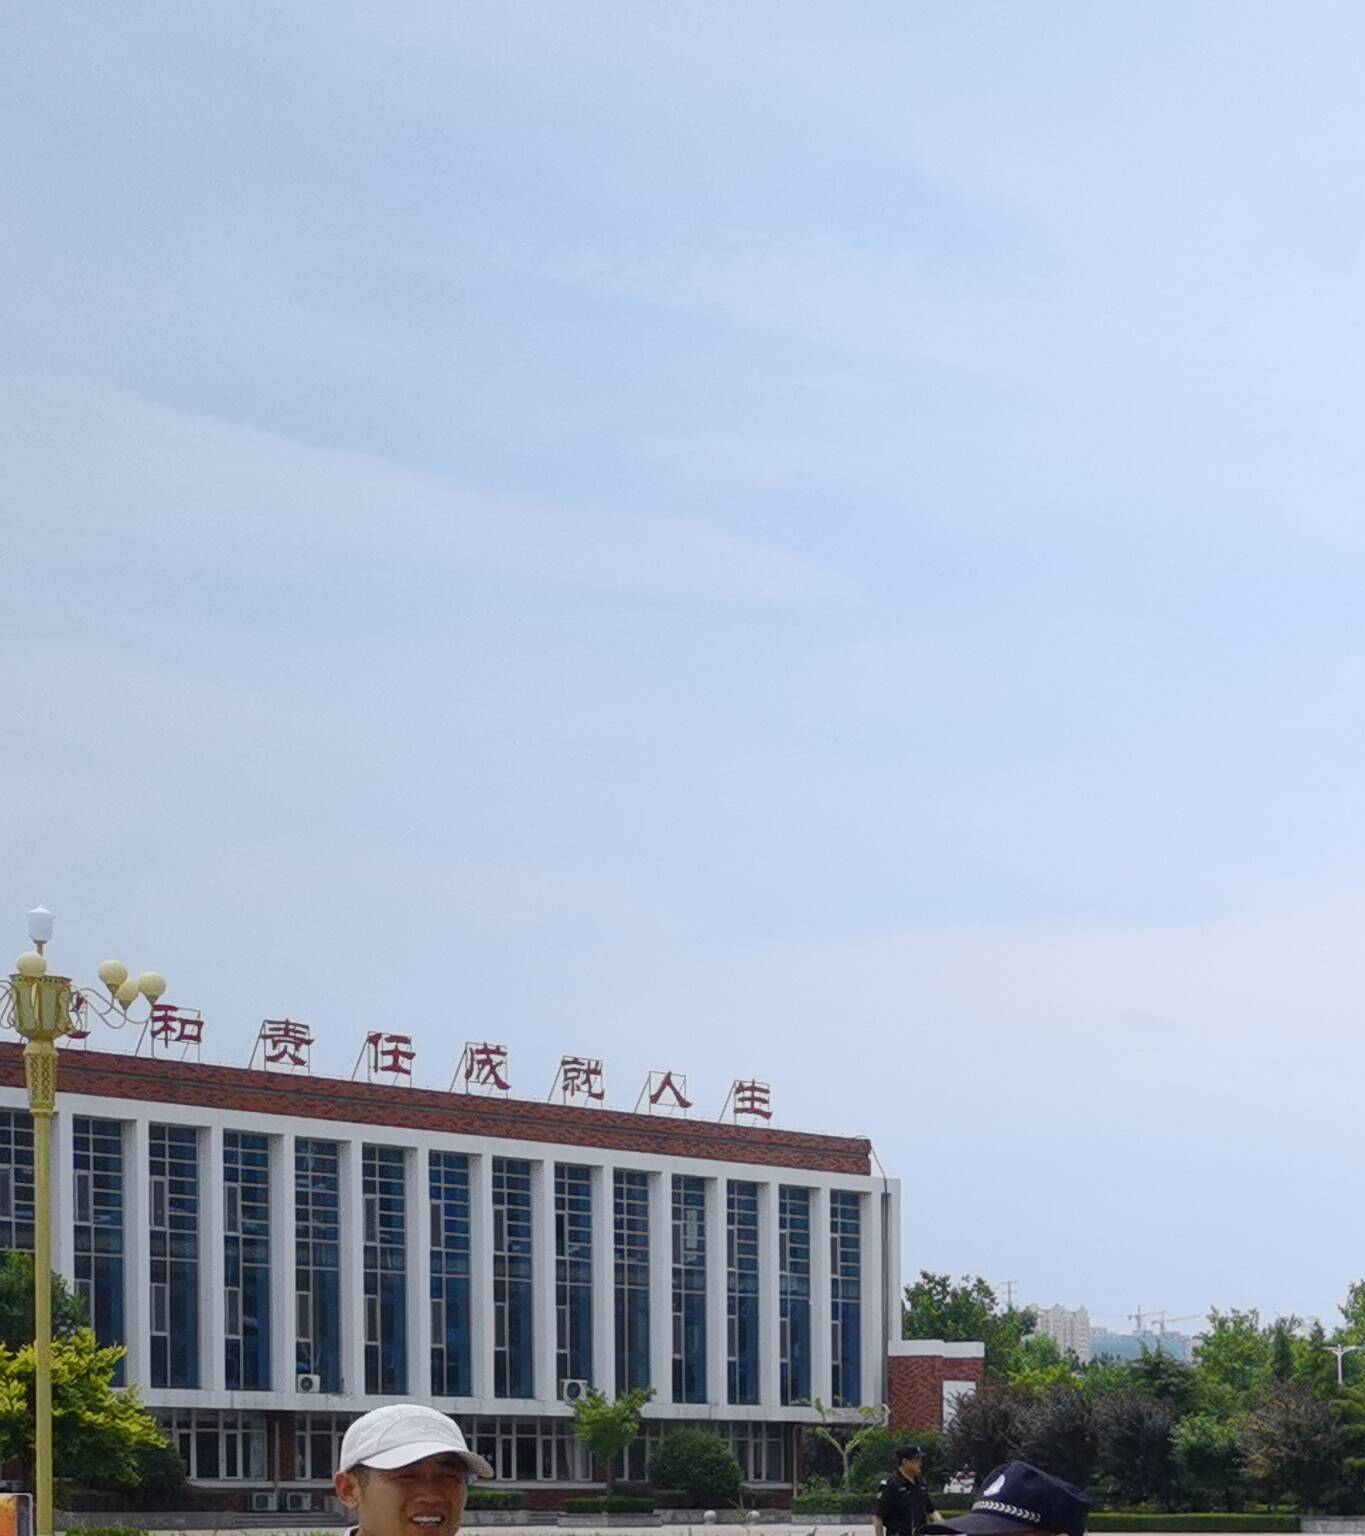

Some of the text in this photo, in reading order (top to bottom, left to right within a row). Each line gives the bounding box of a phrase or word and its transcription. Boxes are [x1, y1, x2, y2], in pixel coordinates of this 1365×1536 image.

[66, 994, 772, 1120] 和责任成就人生
